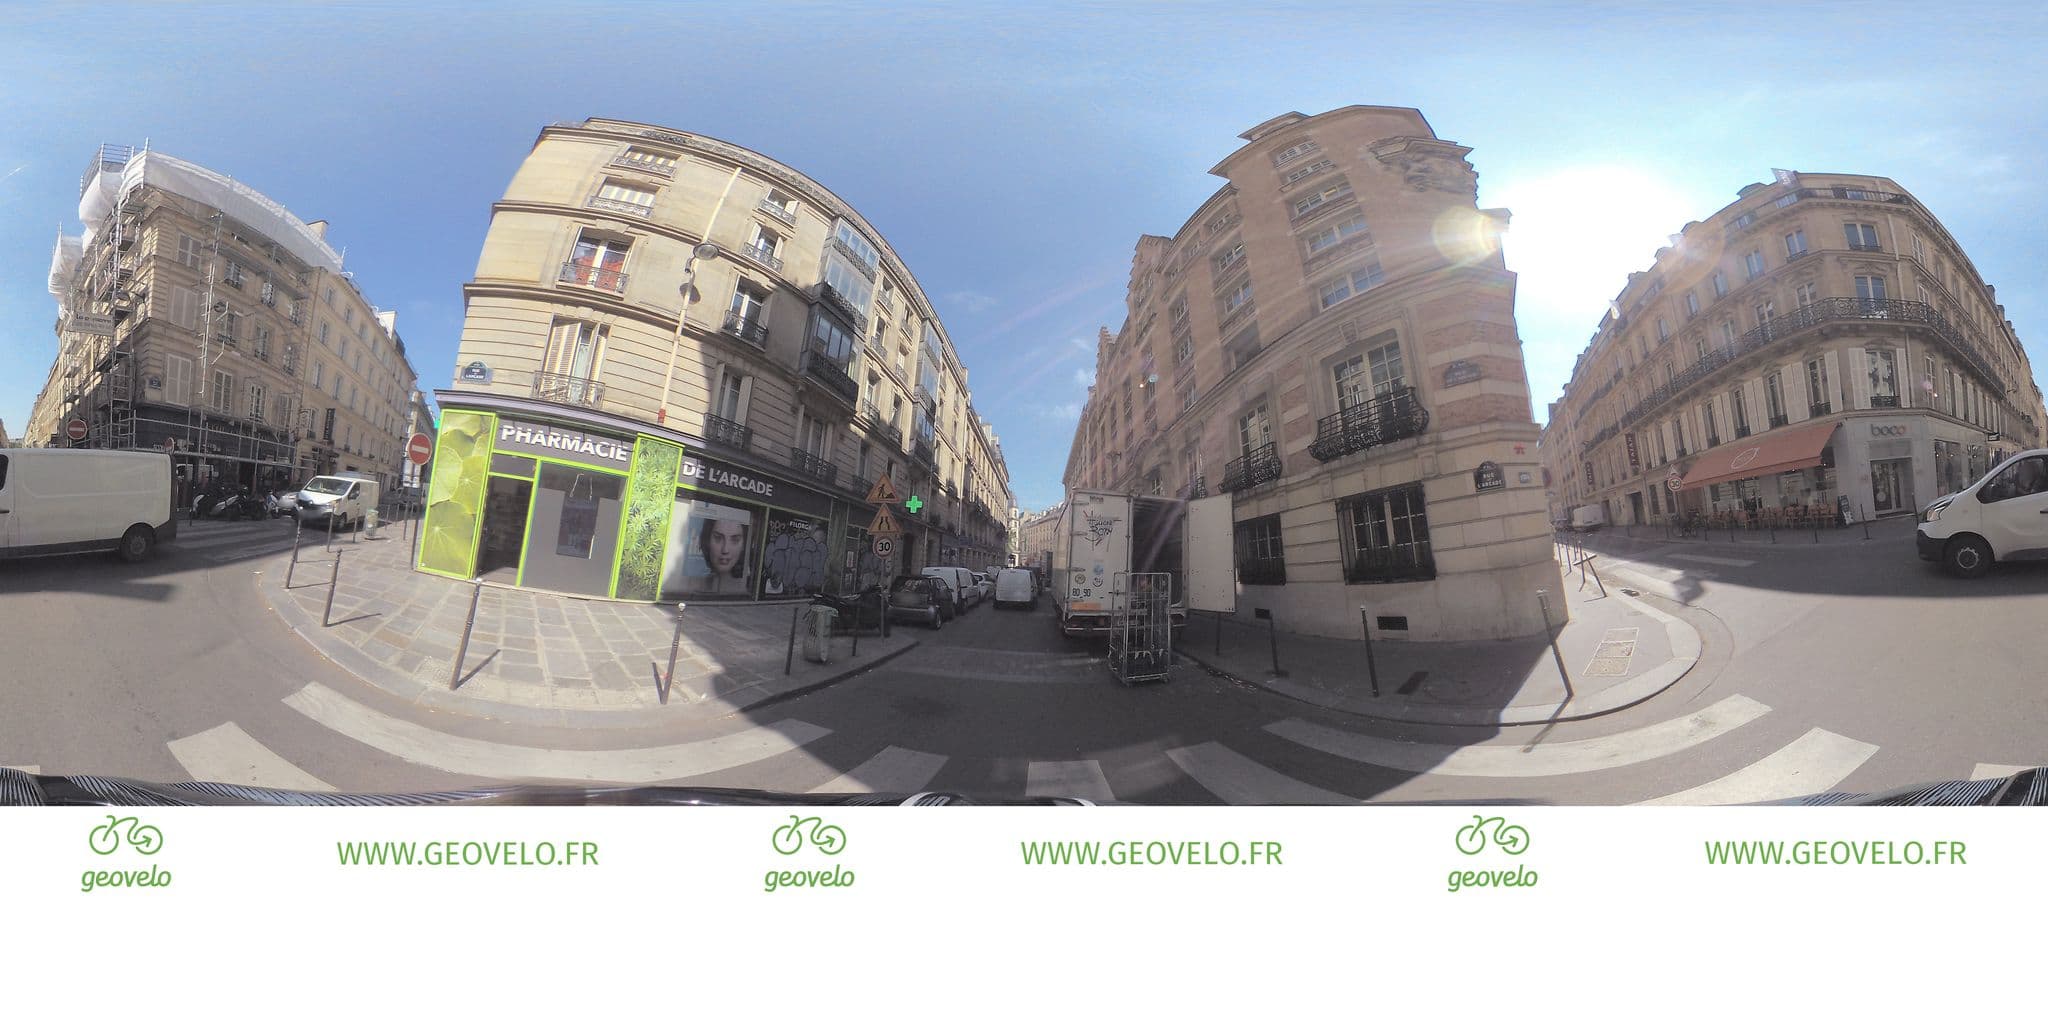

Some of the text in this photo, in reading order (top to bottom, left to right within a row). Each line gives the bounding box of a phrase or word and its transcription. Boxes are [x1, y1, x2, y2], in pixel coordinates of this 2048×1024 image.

[1870, 423, 1907, 437] boco
[501, 425, 629, 462] PHARMACIE
[682, 461, 774, 497] DE L'ARCADE
[879, 541, 891, 552] 30
